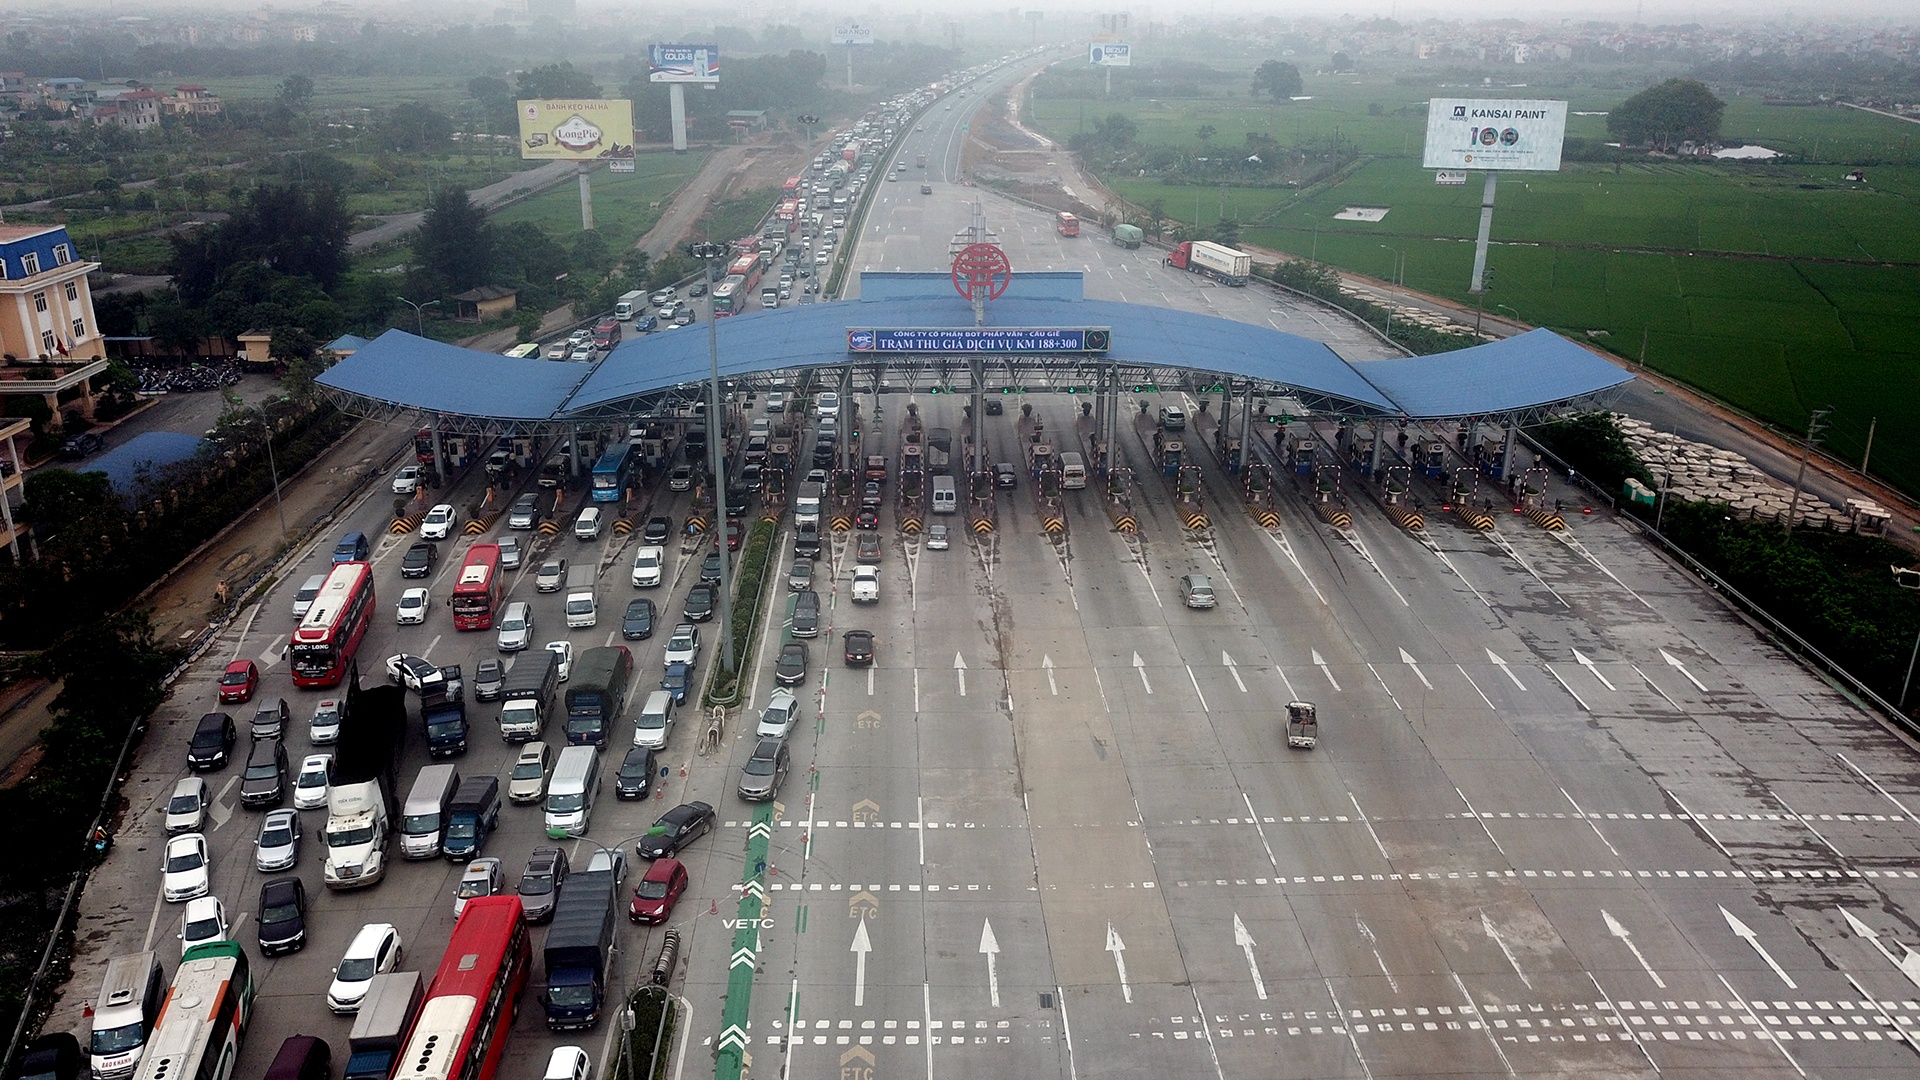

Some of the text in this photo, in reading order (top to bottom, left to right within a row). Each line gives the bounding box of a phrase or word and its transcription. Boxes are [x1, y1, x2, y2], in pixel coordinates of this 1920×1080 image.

[1471, 109, 1546, 119] KANSAI PAINT
[558, 129, 598, 140] LongPie
[1470, 127, 1519, 146] 100
[880, 336, 1077, 351] TRẠM THU GIÁ DỊCH VỤ KM 188+300
[852, 811, 878, 821] ETC
[849, 906, 878, 919] ETC
[722, 918, 775, 929] VETC
